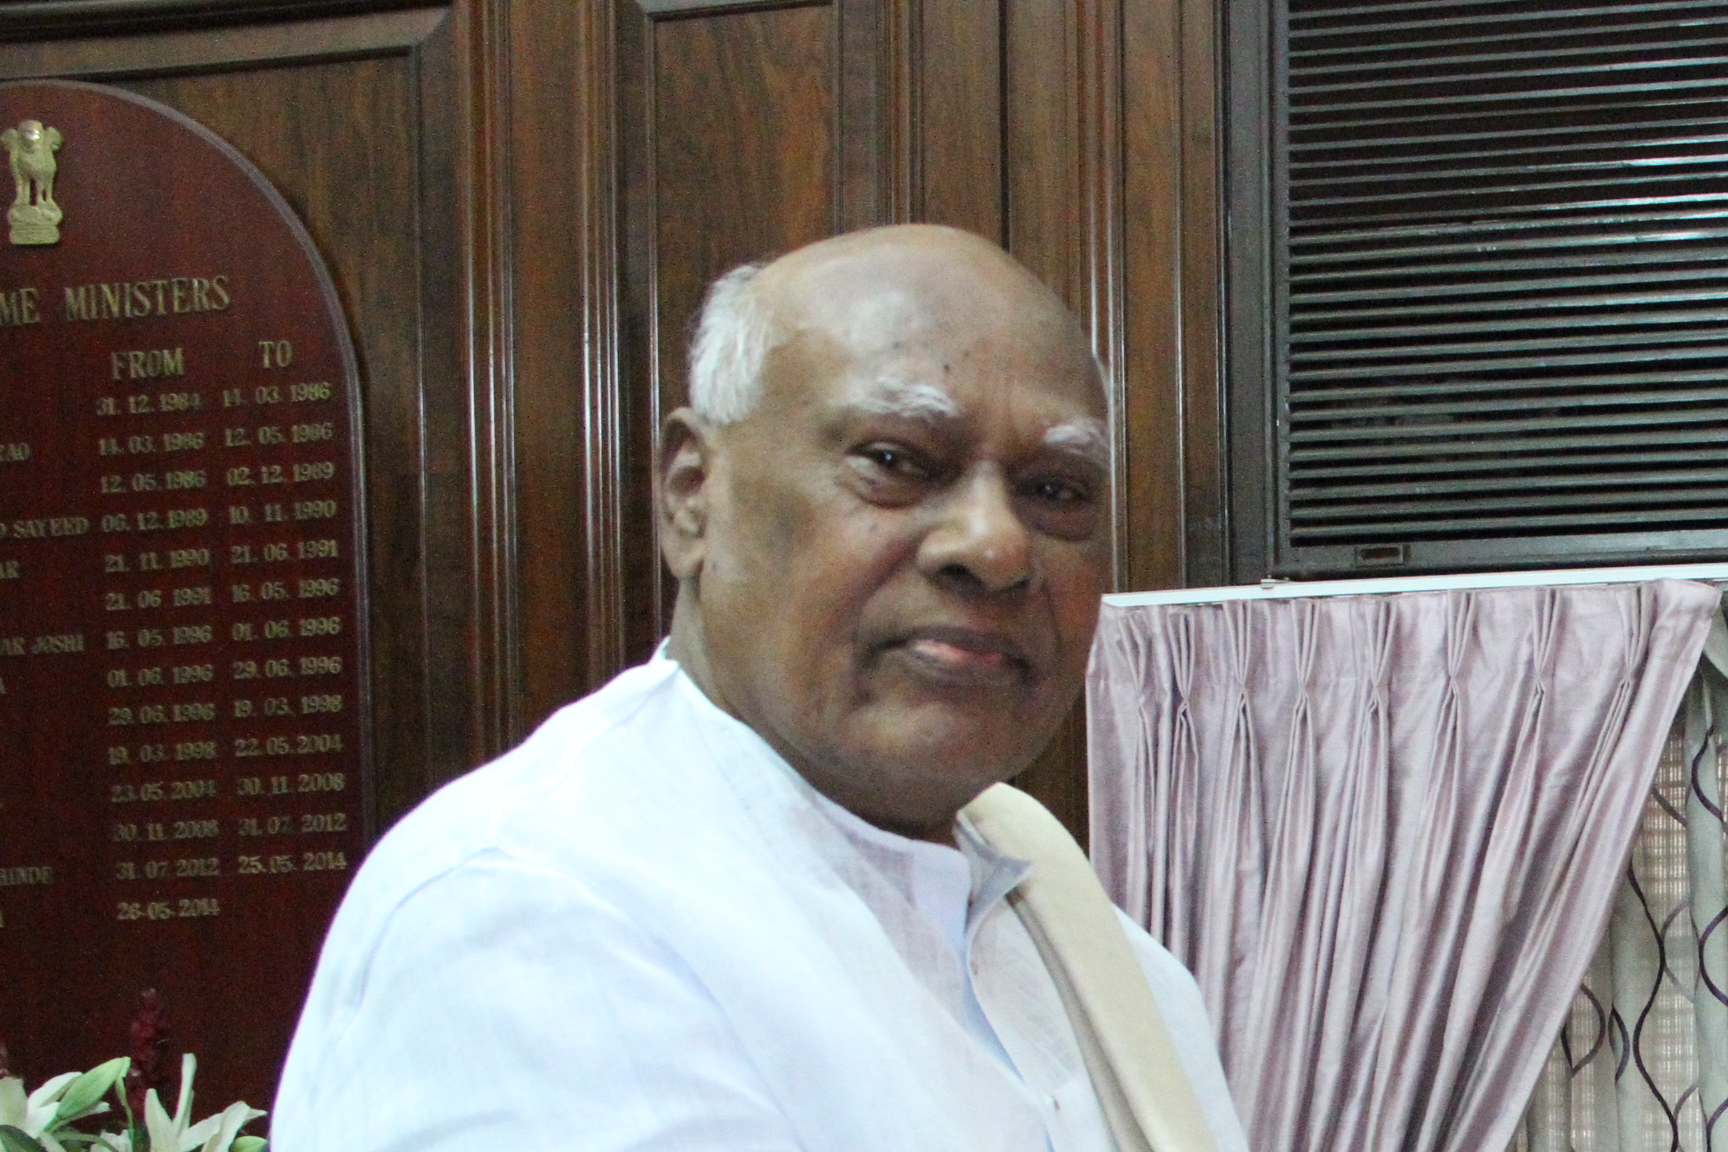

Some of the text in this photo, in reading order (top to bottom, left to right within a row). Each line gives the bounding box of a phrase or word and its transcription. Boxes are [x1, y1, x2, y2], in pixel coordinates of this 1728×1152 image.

[64, 275, 231, 322] MINISTERS
[111, 340, 292, 380] FROM TO
